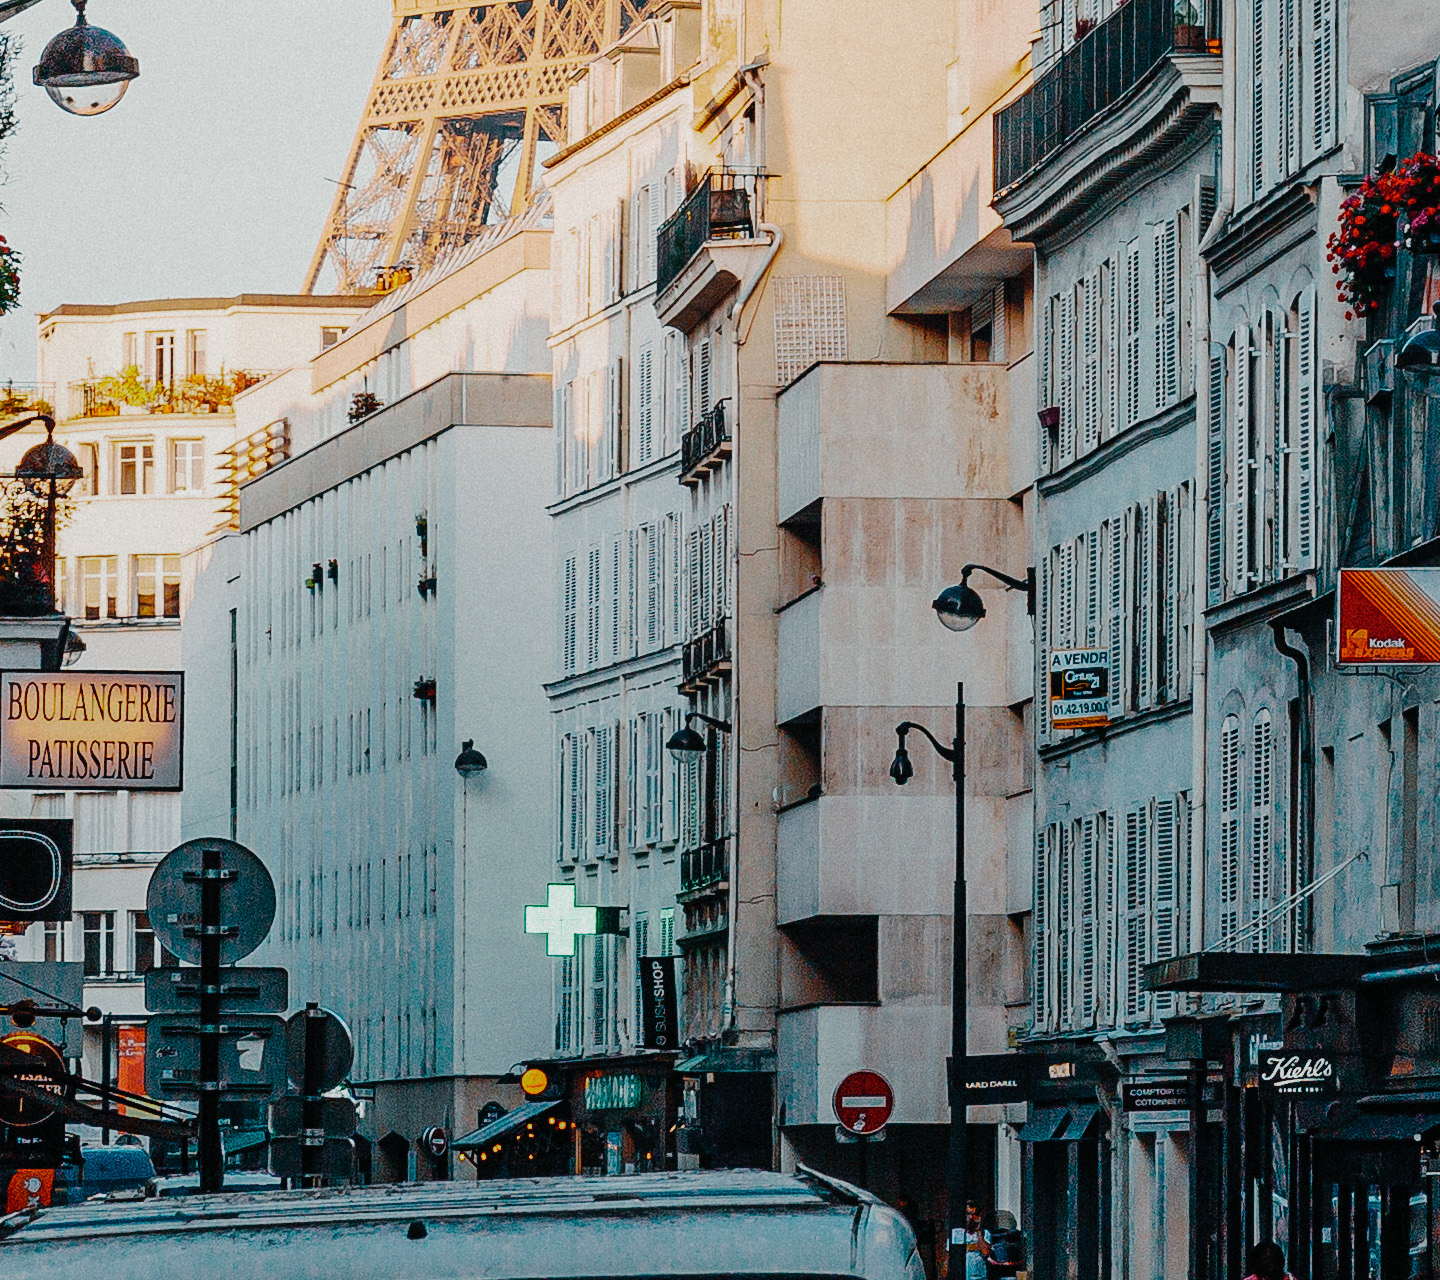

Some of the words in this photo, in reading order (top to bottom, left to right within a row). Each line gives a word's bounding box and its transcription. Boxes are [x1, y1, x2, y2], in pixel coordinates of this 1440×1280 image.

[1369, 638, 1406, 649] Kodak
[1051, 654, 1062, 666] A
[1064, 651, 1108, 666] VENDR
[7, 681, 176, 723] BOULANGERIE
[27, 739, 155, 780] PATISSERIE
[1261, 1055, 1333, 1082] Kiehl's
